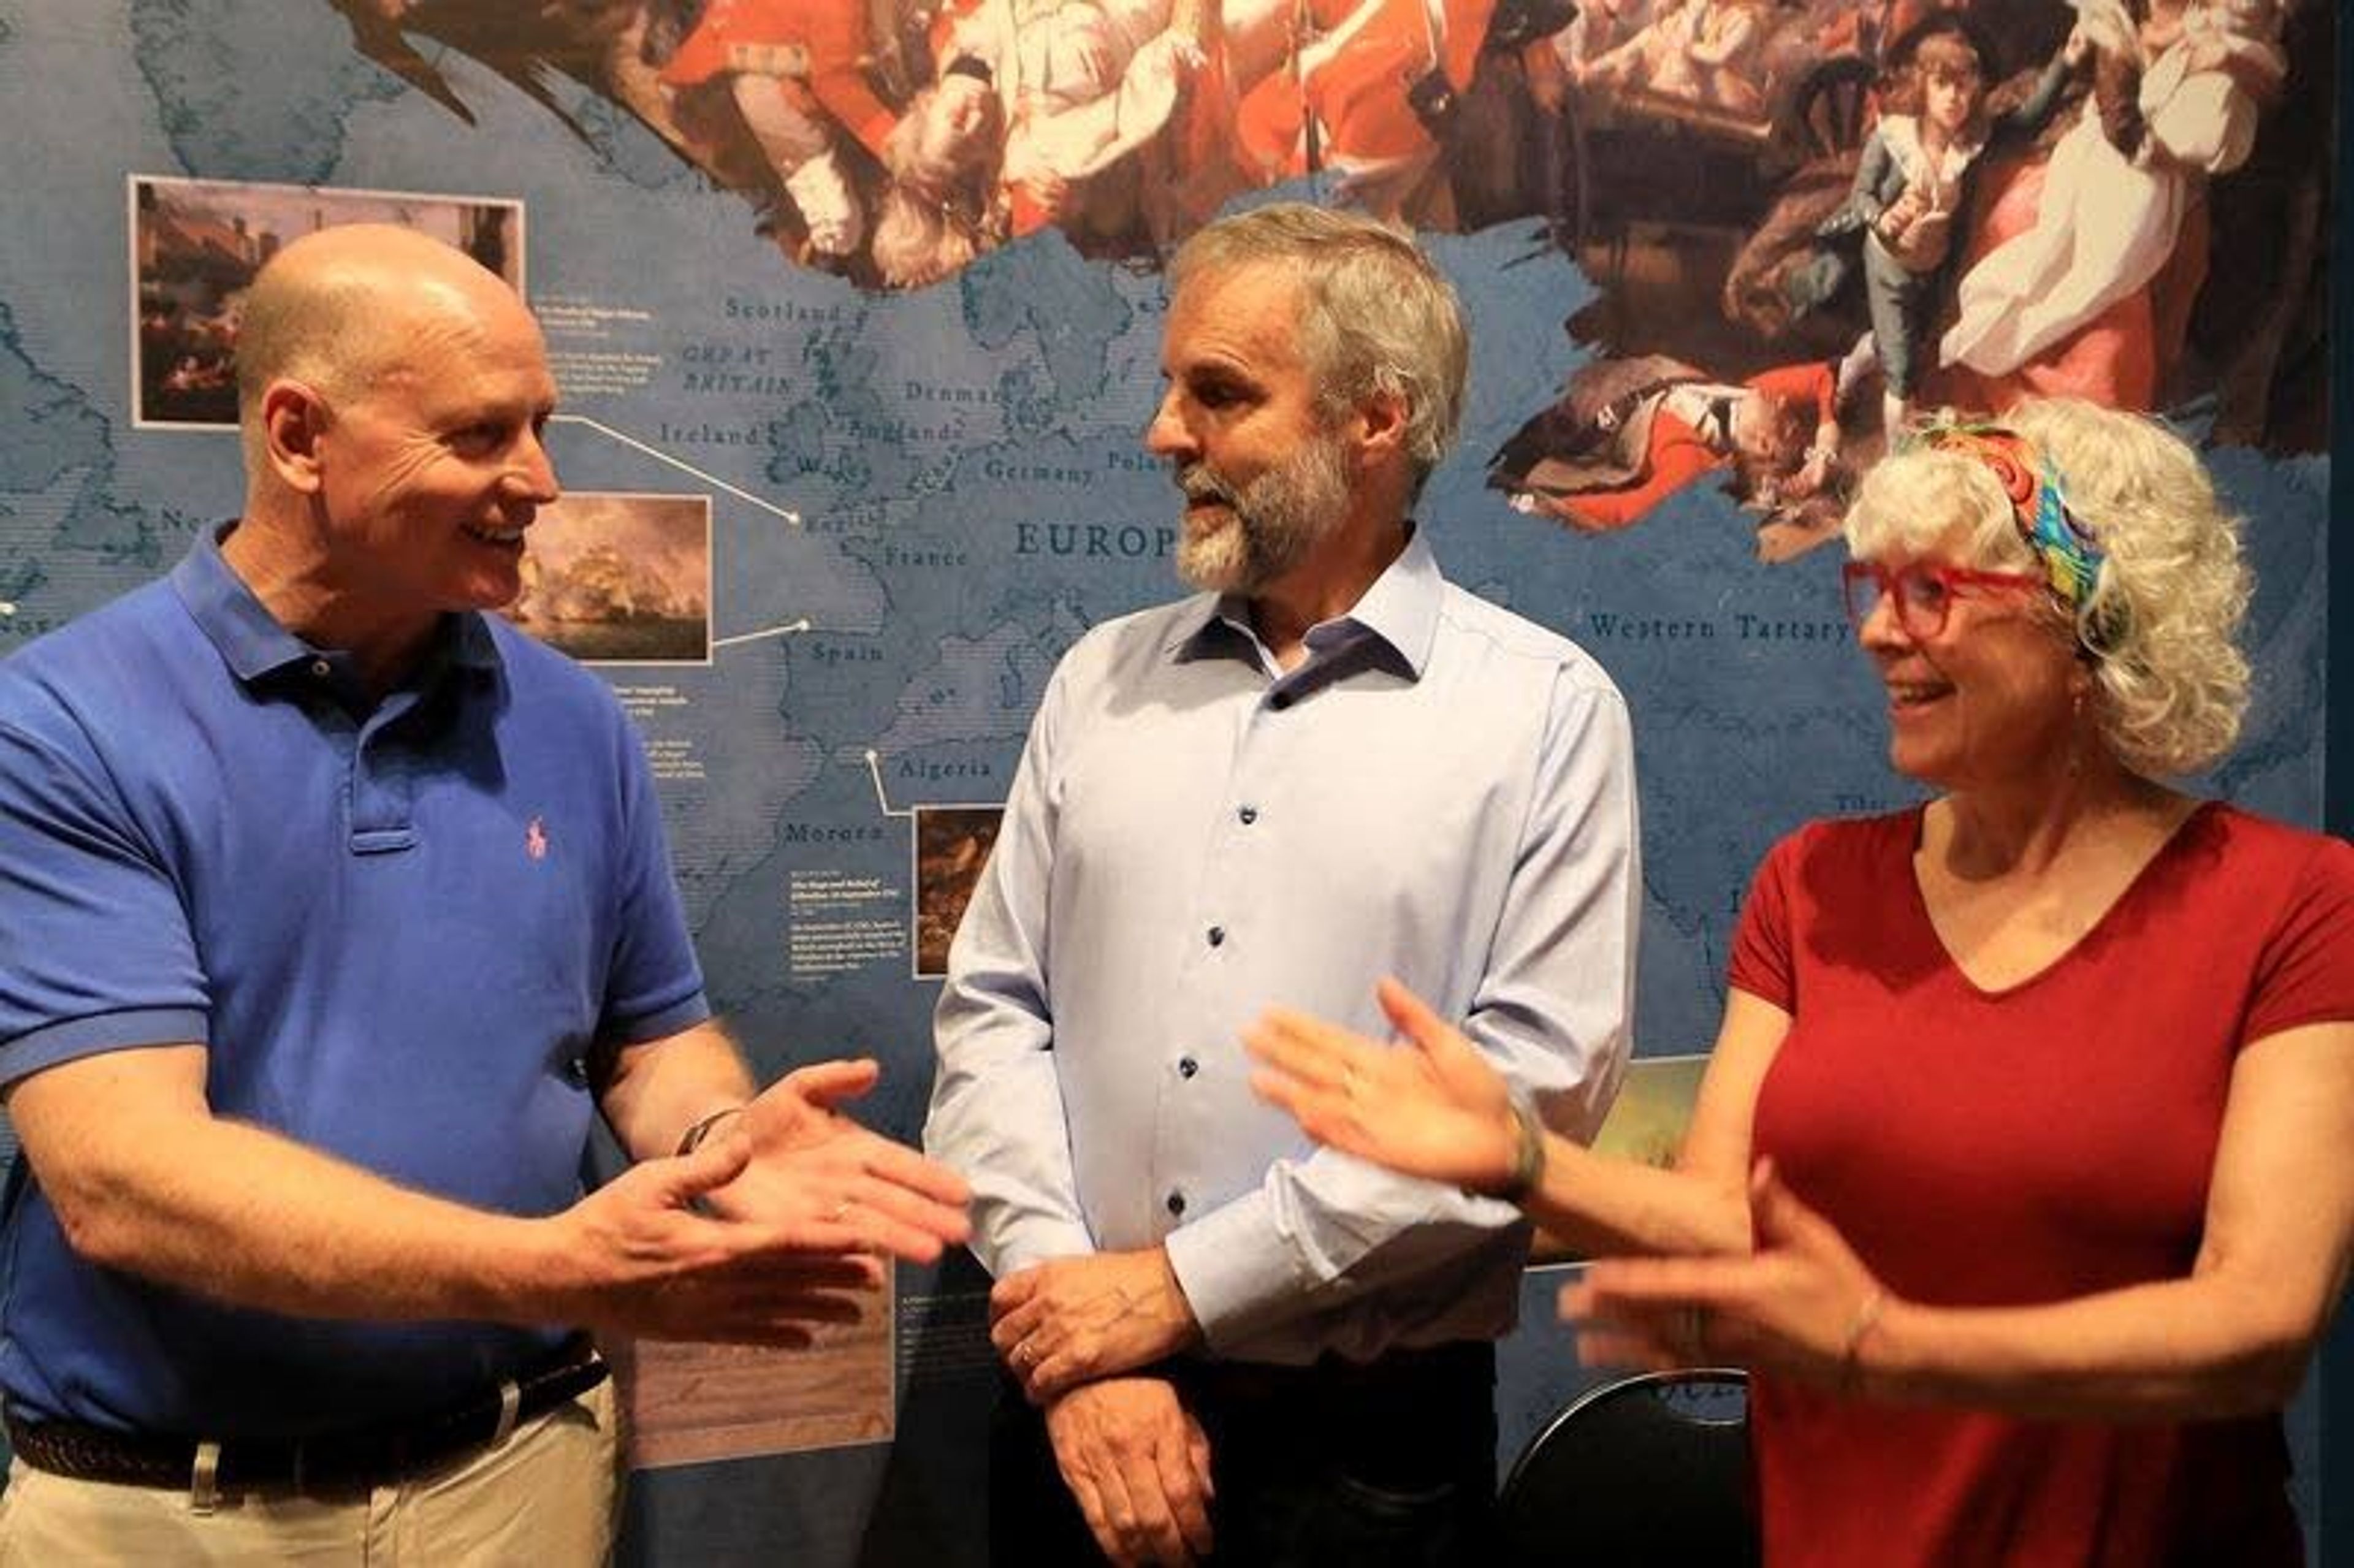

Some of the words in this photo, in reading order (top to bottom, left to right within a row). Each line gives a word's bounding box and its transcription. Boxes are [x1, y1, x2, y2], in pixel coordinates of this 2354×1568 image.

[726, 298, 841, 321] Scotland
[660, 423, 759, 445] Ireland
[985, 459, 1094, 487] Germany
[1015, 522, 1175, 557] EUROP
[885, 546, 967, 565] France
[1591, 615, 1715, 639] Western
[1735, 615, 1850, 642] Tartary
[810, 643, 885, 664] Spain
[899, 760, 991, 780] Algeria
